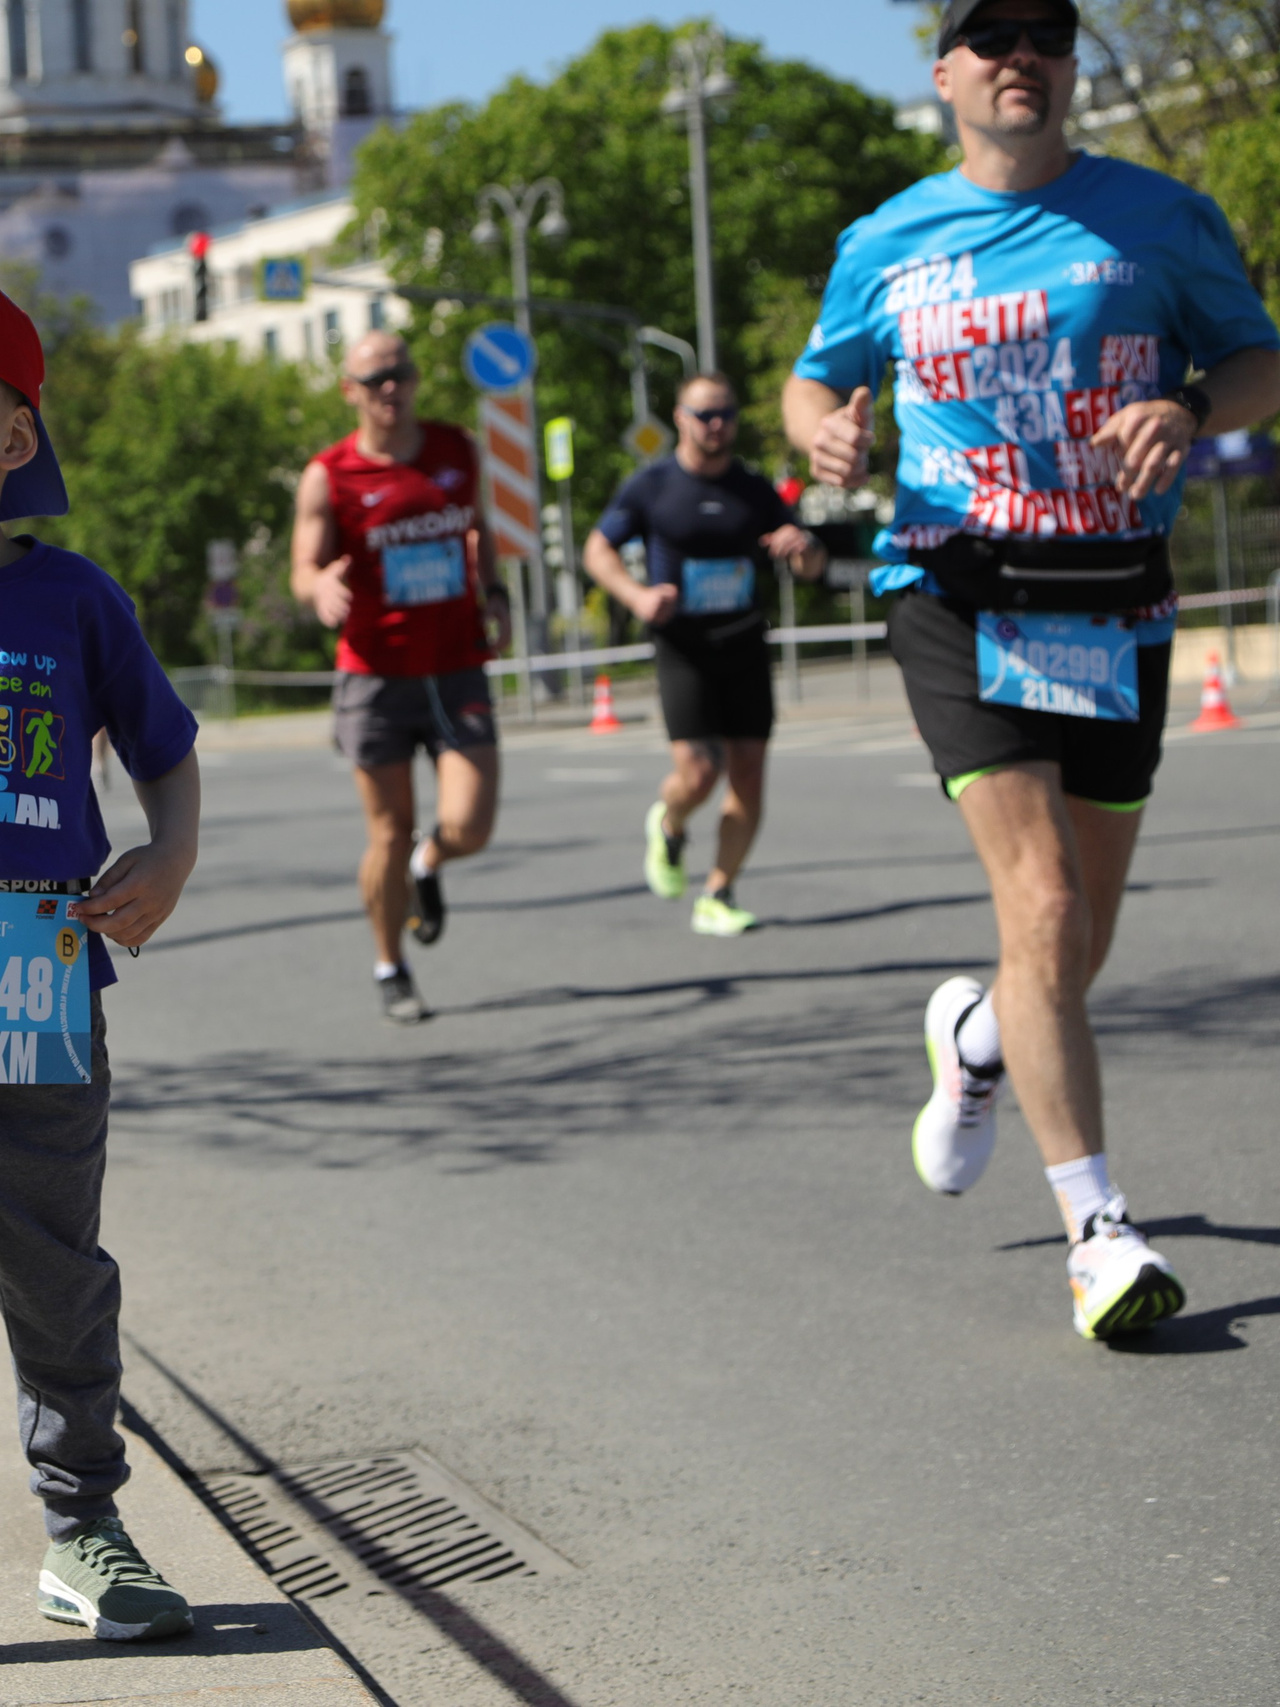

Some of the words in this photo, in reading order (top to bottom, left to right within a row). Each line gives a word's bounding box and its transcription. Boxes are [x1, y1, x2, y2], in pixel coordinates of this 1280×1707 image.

[882, 251, 978, 314] 2024
[900, 290, 1049, 359] #МЕЧТА
[34, 654, 57, 676] up
[29, 681, 53, 698] an
[62, 933, 74, 957] B
